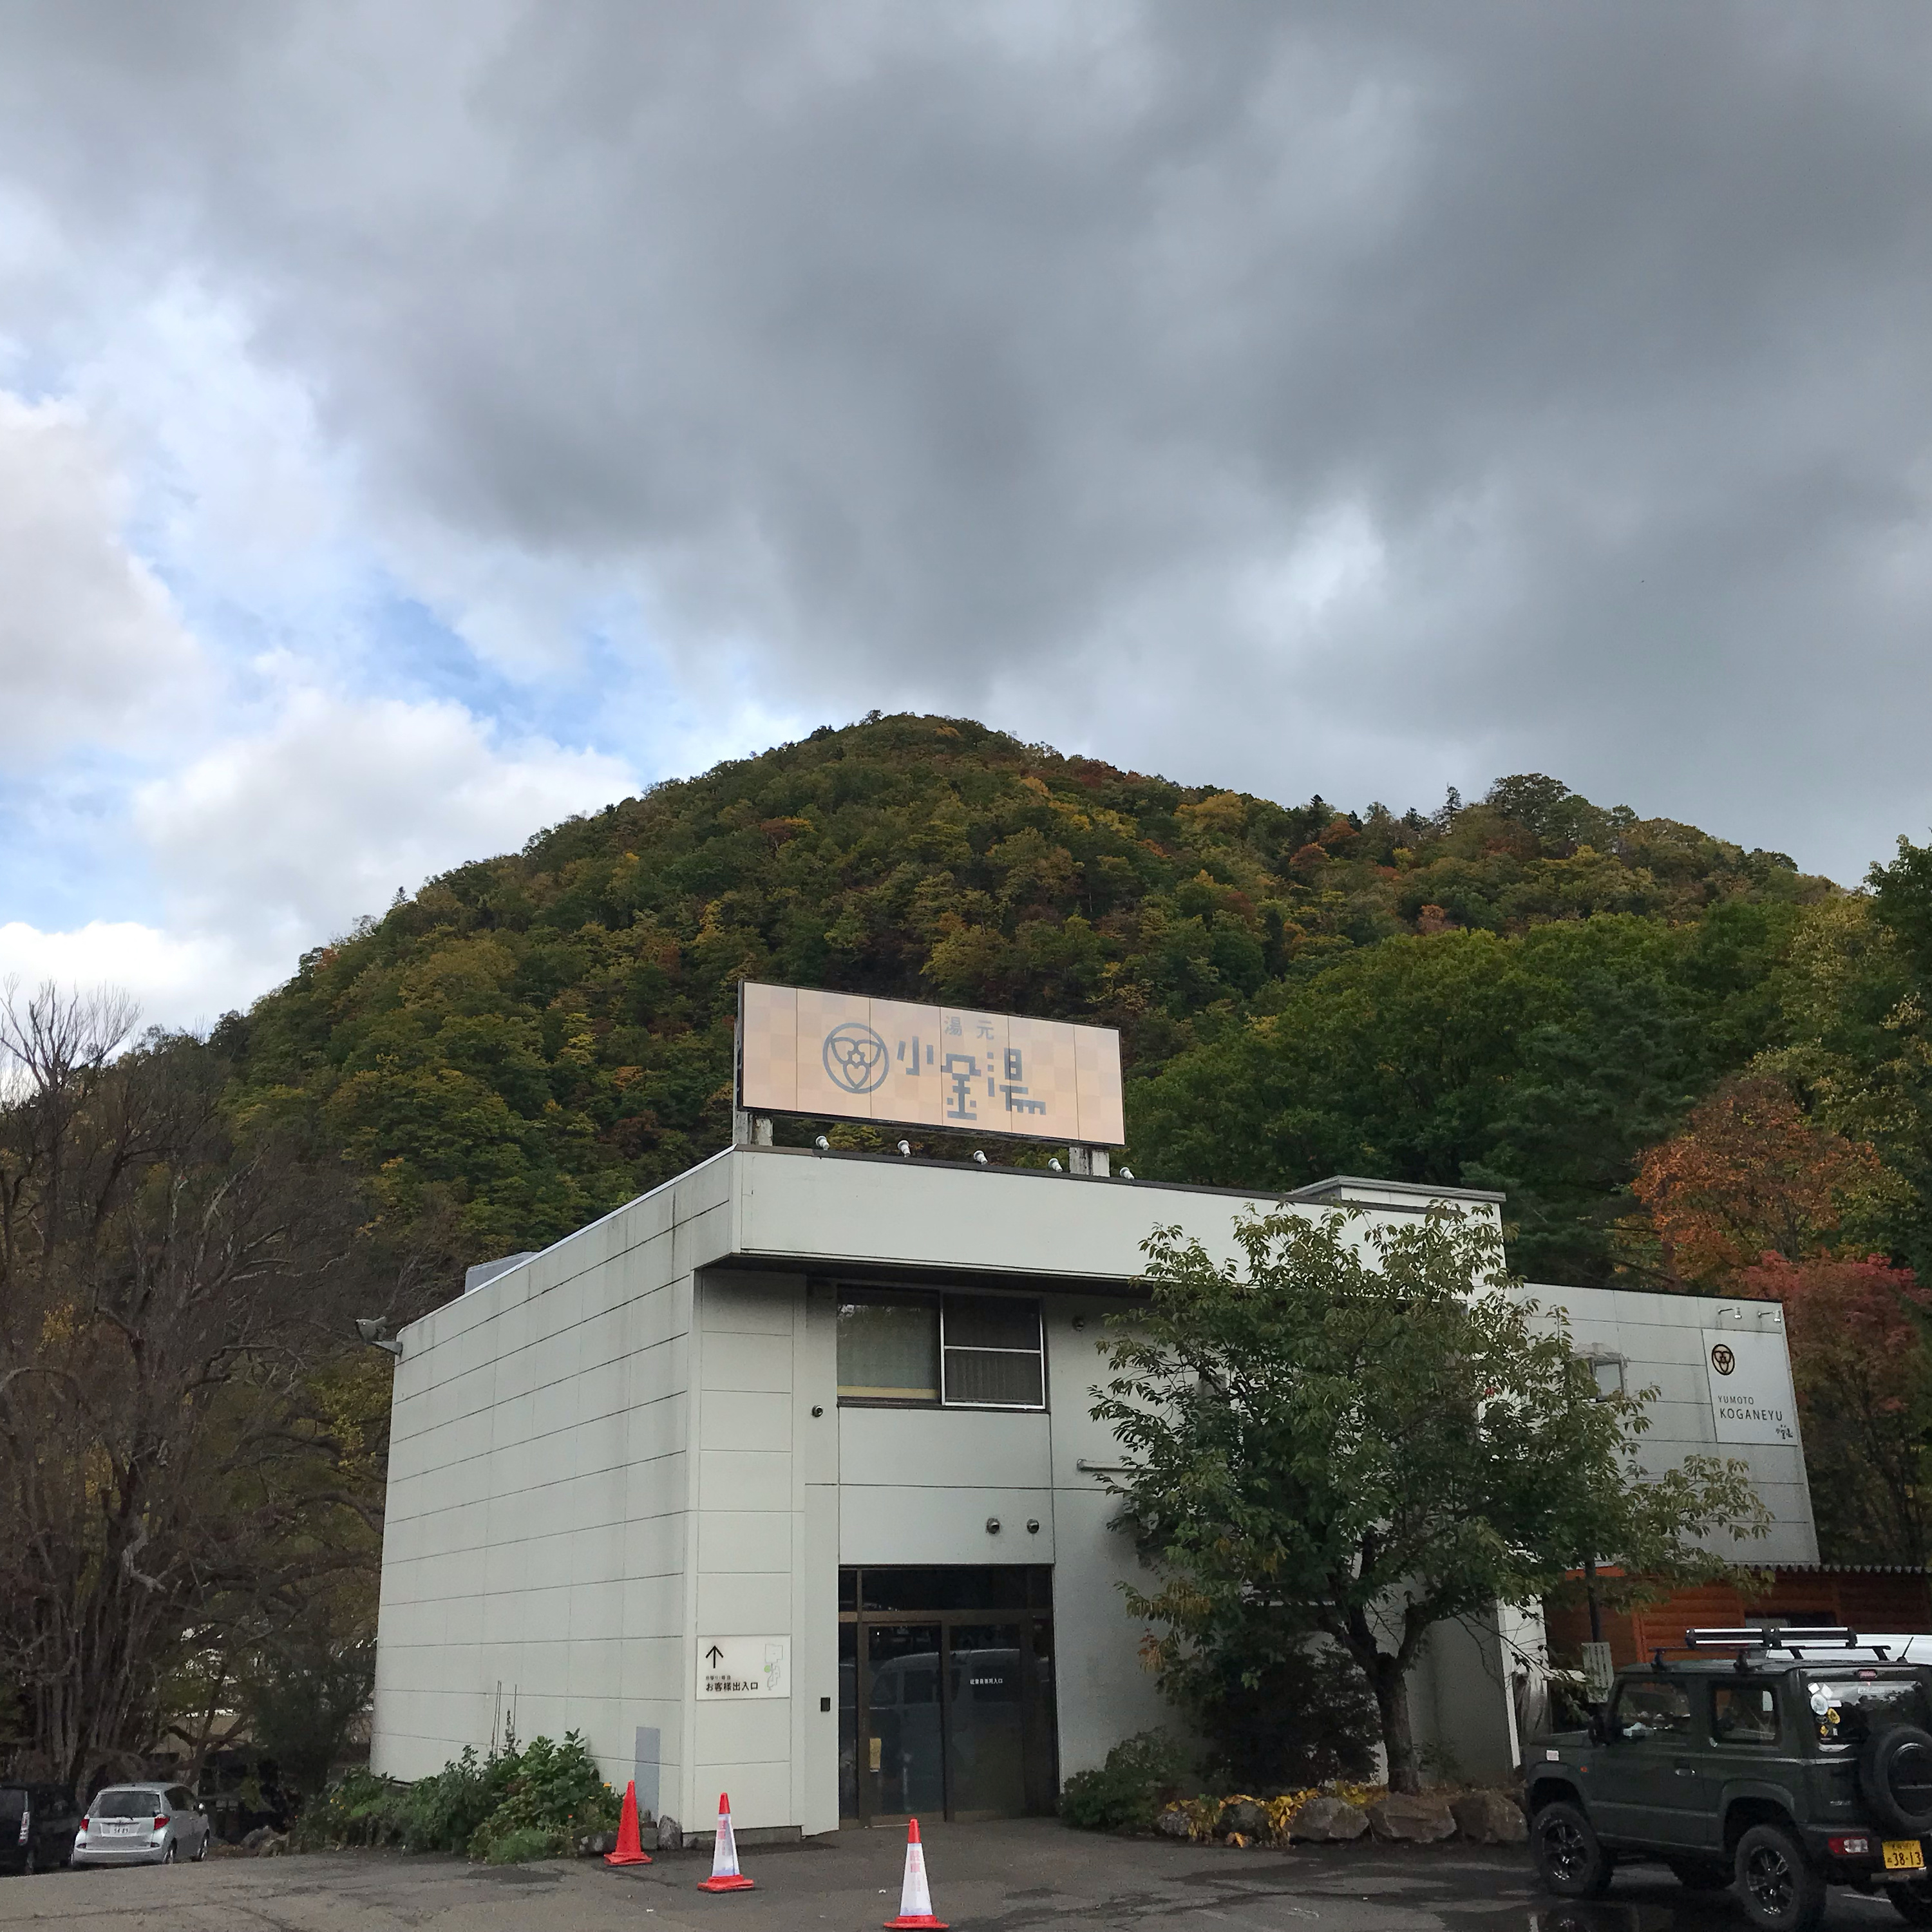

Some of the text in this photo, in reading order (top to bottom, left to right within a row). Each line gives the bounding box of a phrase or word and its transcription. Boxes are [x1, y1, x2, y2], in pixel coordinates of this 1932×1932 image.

[945, 1016, 994, 1039] 湯元
[897, 1036, 1046, 1120] 小金湯
[1718, 1396, 1754, 1405] YUMOTO
[1720, 1408, 1782, 1421] KOGANEYU
[706, 1681, 758, 1692] お客様出入口
[1892, 1852, 1921, 1866] 38-13
